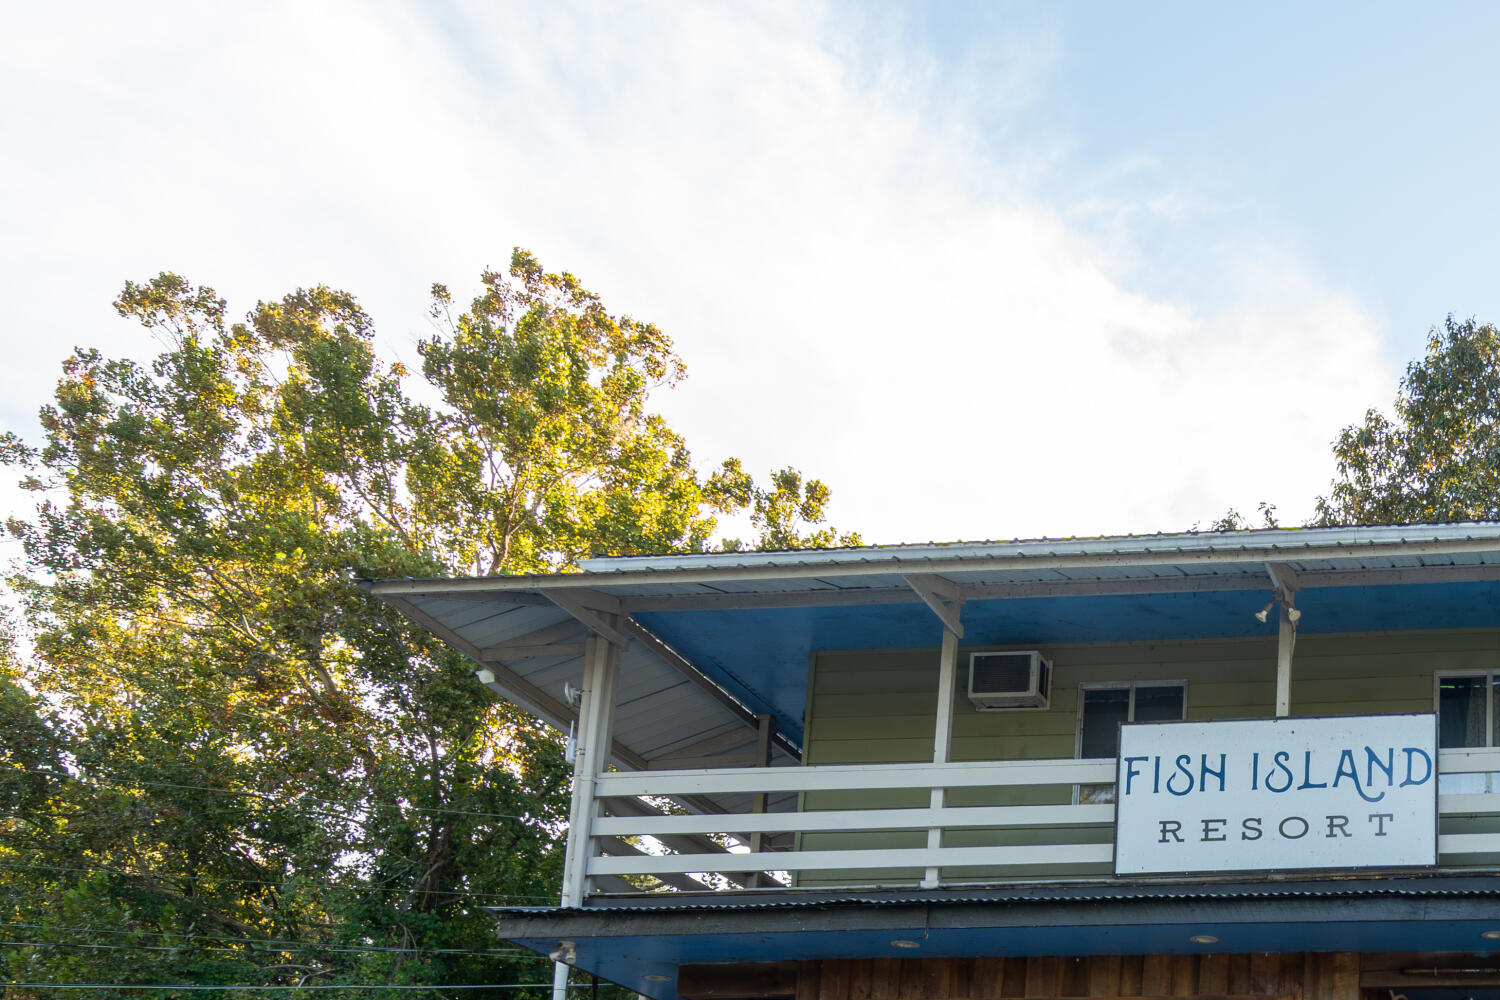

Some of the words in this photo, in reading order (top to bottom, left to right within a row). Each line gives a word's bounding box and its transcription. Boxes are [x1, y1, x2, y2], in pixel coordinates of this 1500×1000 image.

[1124, 753, 1227, 796] FISH
[1251, 746, 1433, 802] ISLAND
[1158, 813, 1394, 843] RESORT
